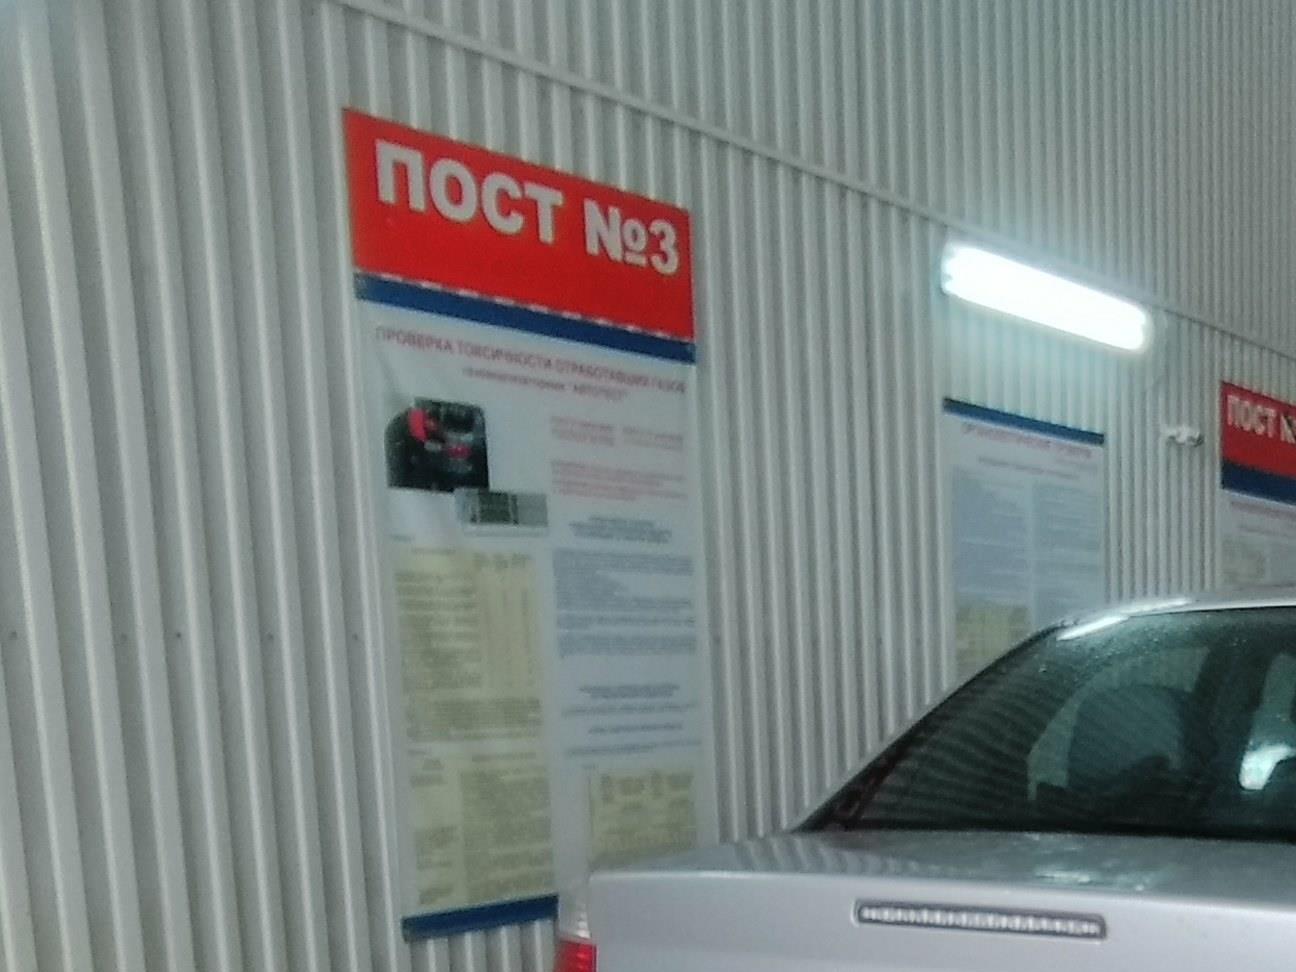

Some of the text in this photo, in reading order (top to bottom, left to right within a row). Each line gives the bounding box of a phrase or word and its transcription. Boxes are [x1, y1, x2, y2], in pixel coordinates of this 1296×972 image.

[375, 138, 679, 275] ПОСТ №3
[1227, 394, 1277, 438] ПОСТ
